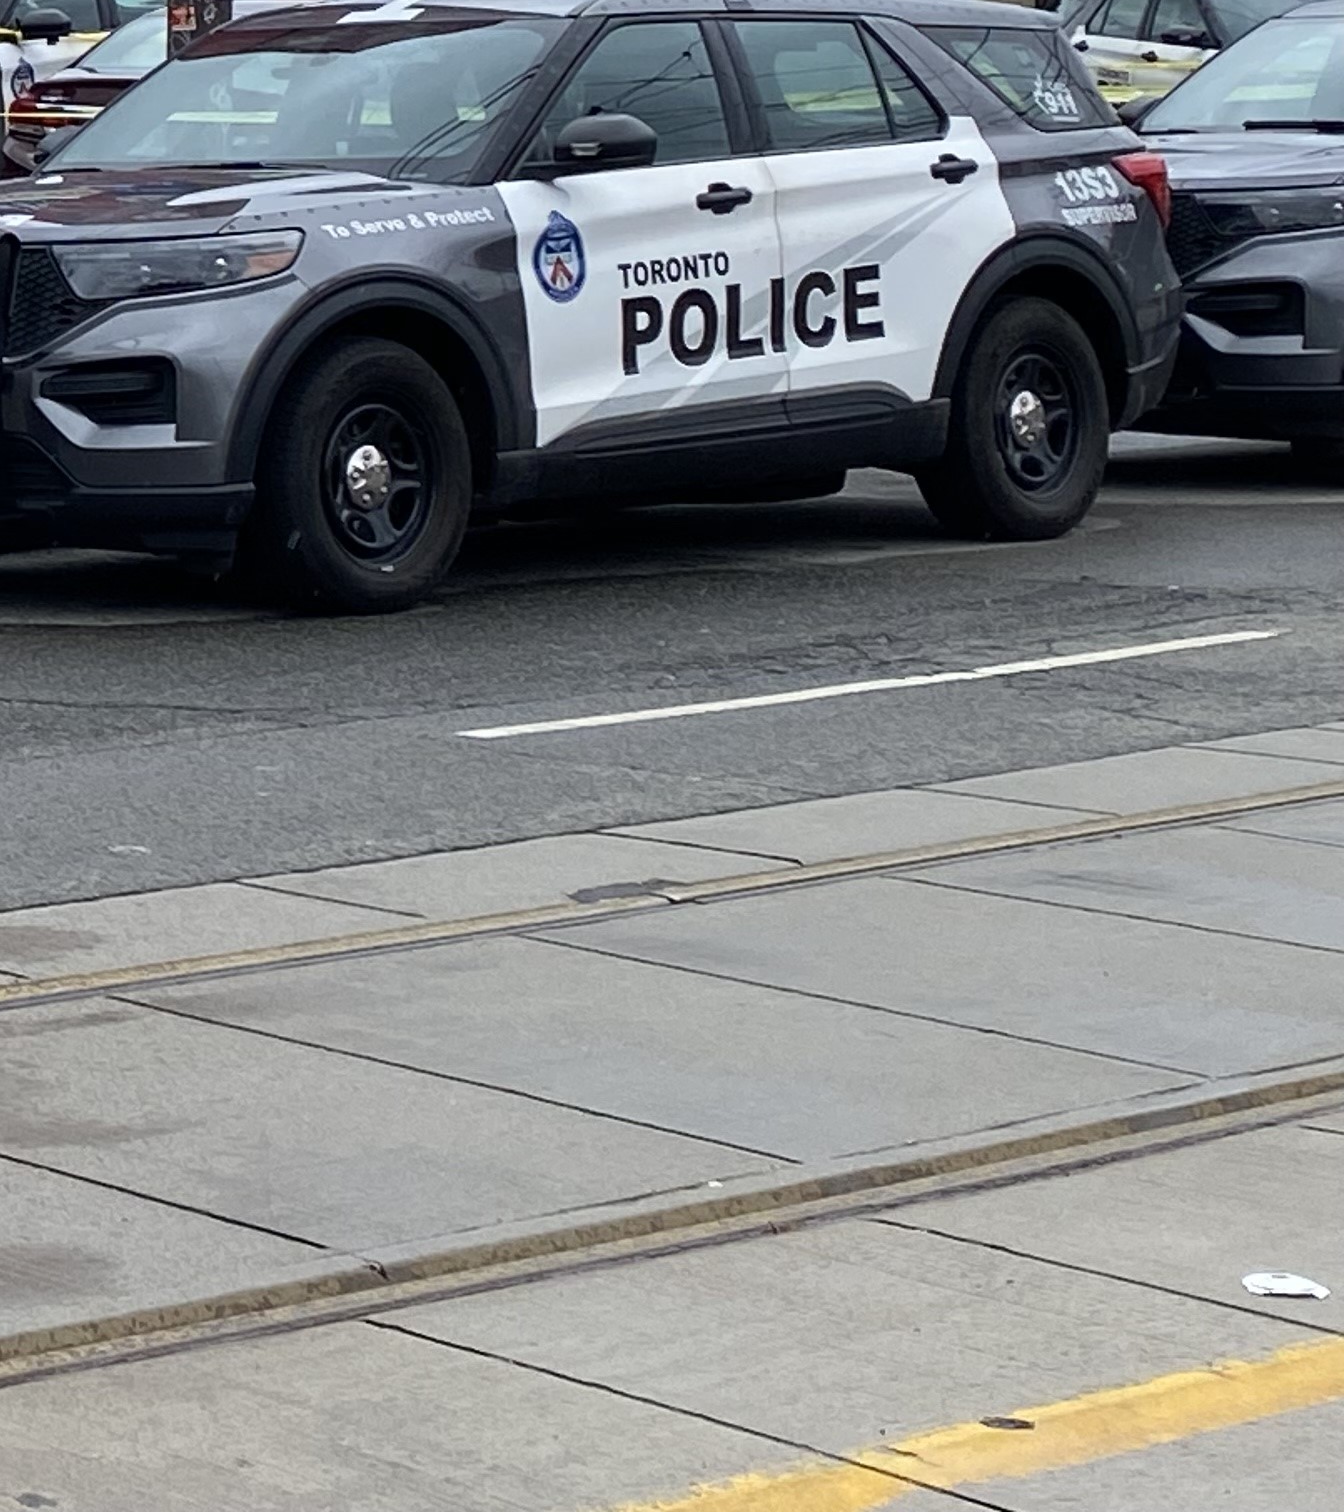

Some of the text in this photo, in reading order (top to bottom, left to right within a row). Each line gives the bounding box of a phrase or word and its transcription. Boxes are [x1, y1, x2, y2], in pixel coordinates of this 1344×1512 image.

[320, 206, 496, 239] To Serve & Protect
[617, 251, 730, 289] TORONTO
[621, 263, 886, 376] POLICE
